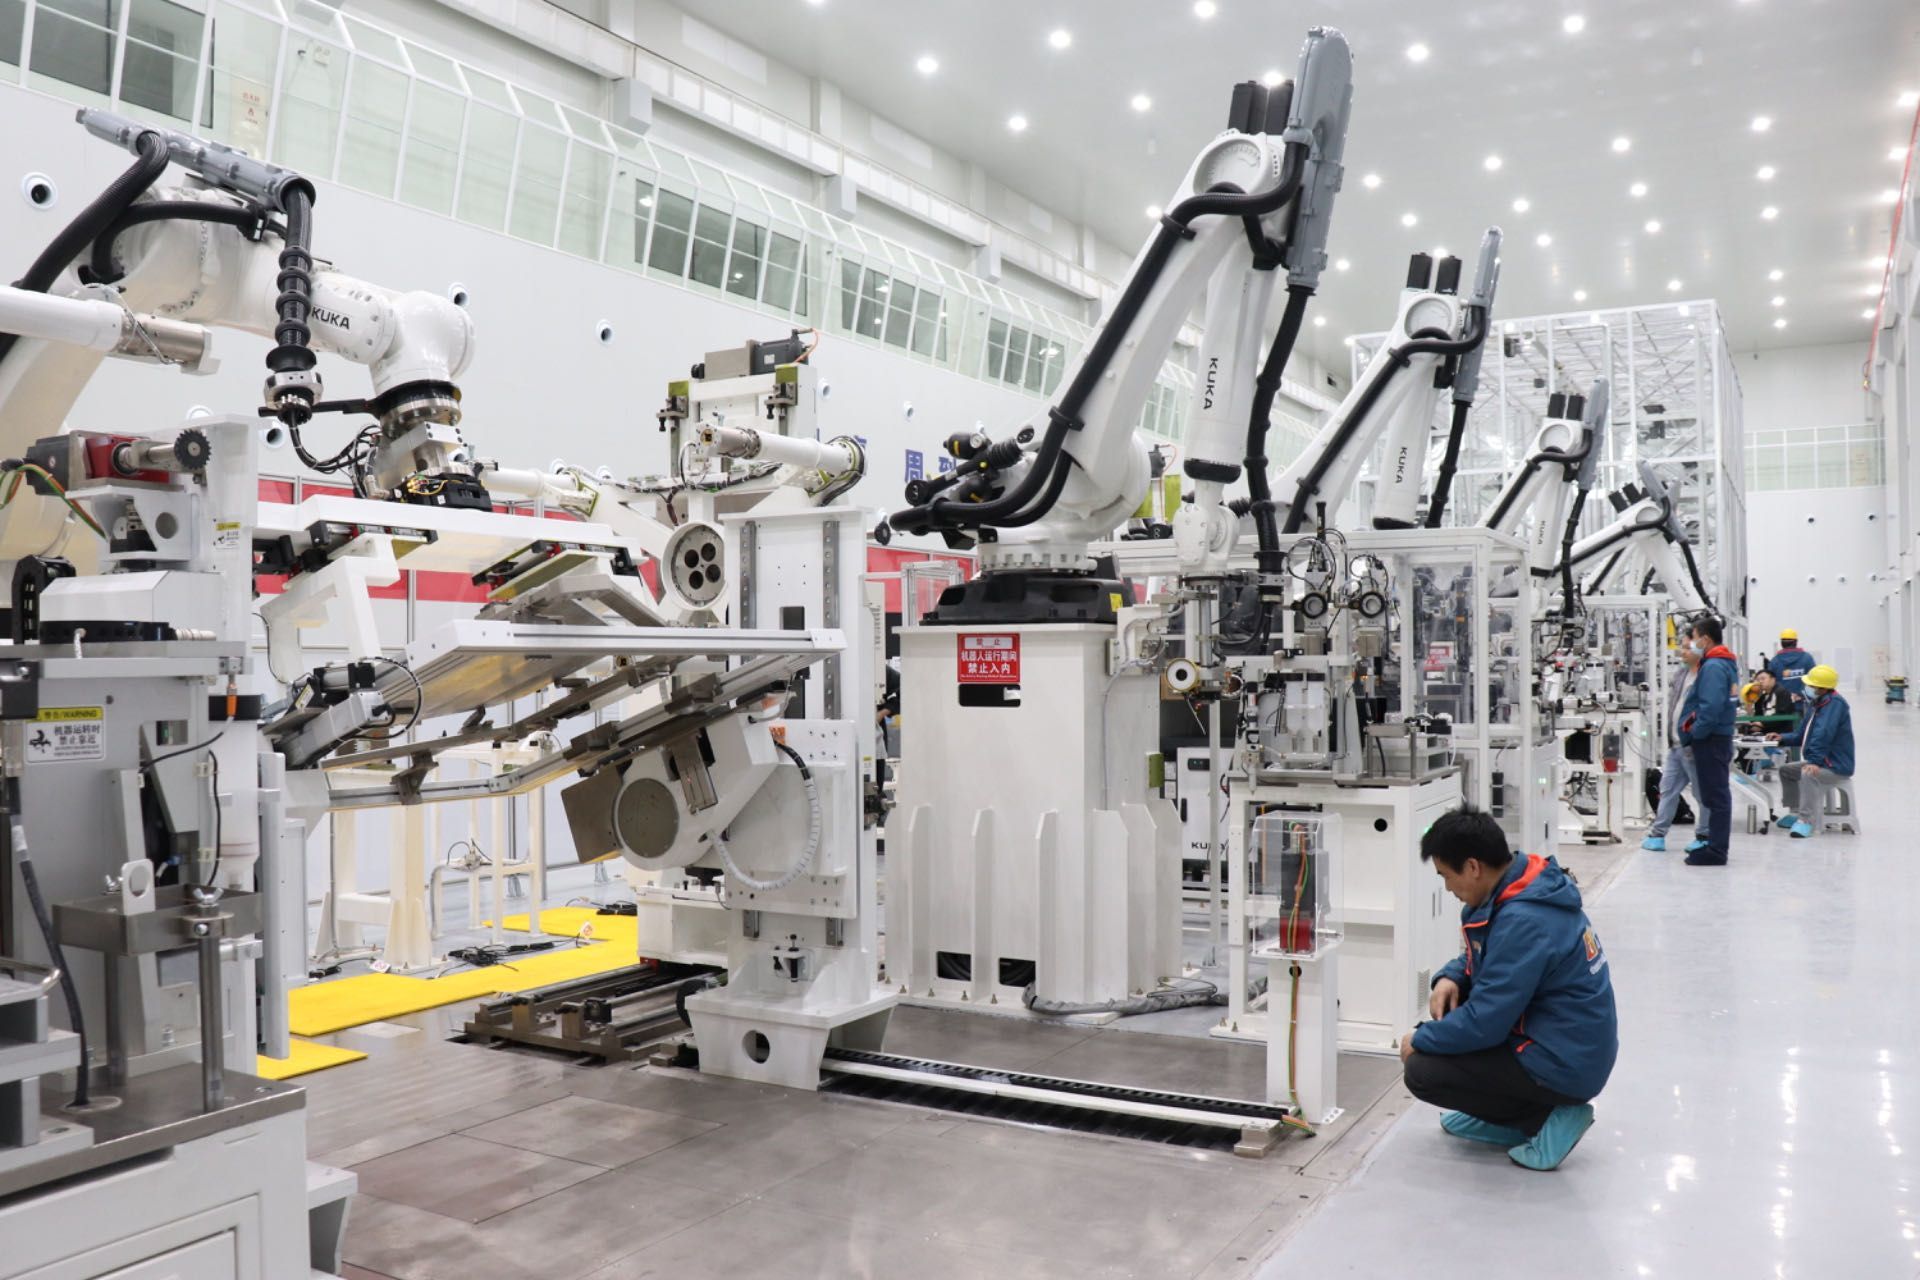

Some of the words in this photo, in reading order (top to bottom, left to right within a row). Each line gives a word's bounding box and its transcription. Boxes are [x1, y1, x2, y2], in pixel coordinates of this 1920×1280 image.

[311, 306, 350, 330] KUKA
[1203, 357, 1219, 410] KUKA
[1395, 446, 1407, 484] KUKA
[960, 649, 1017, 662] 机器人运行期间
[968, 662, 1011, 675] 禁止入内
